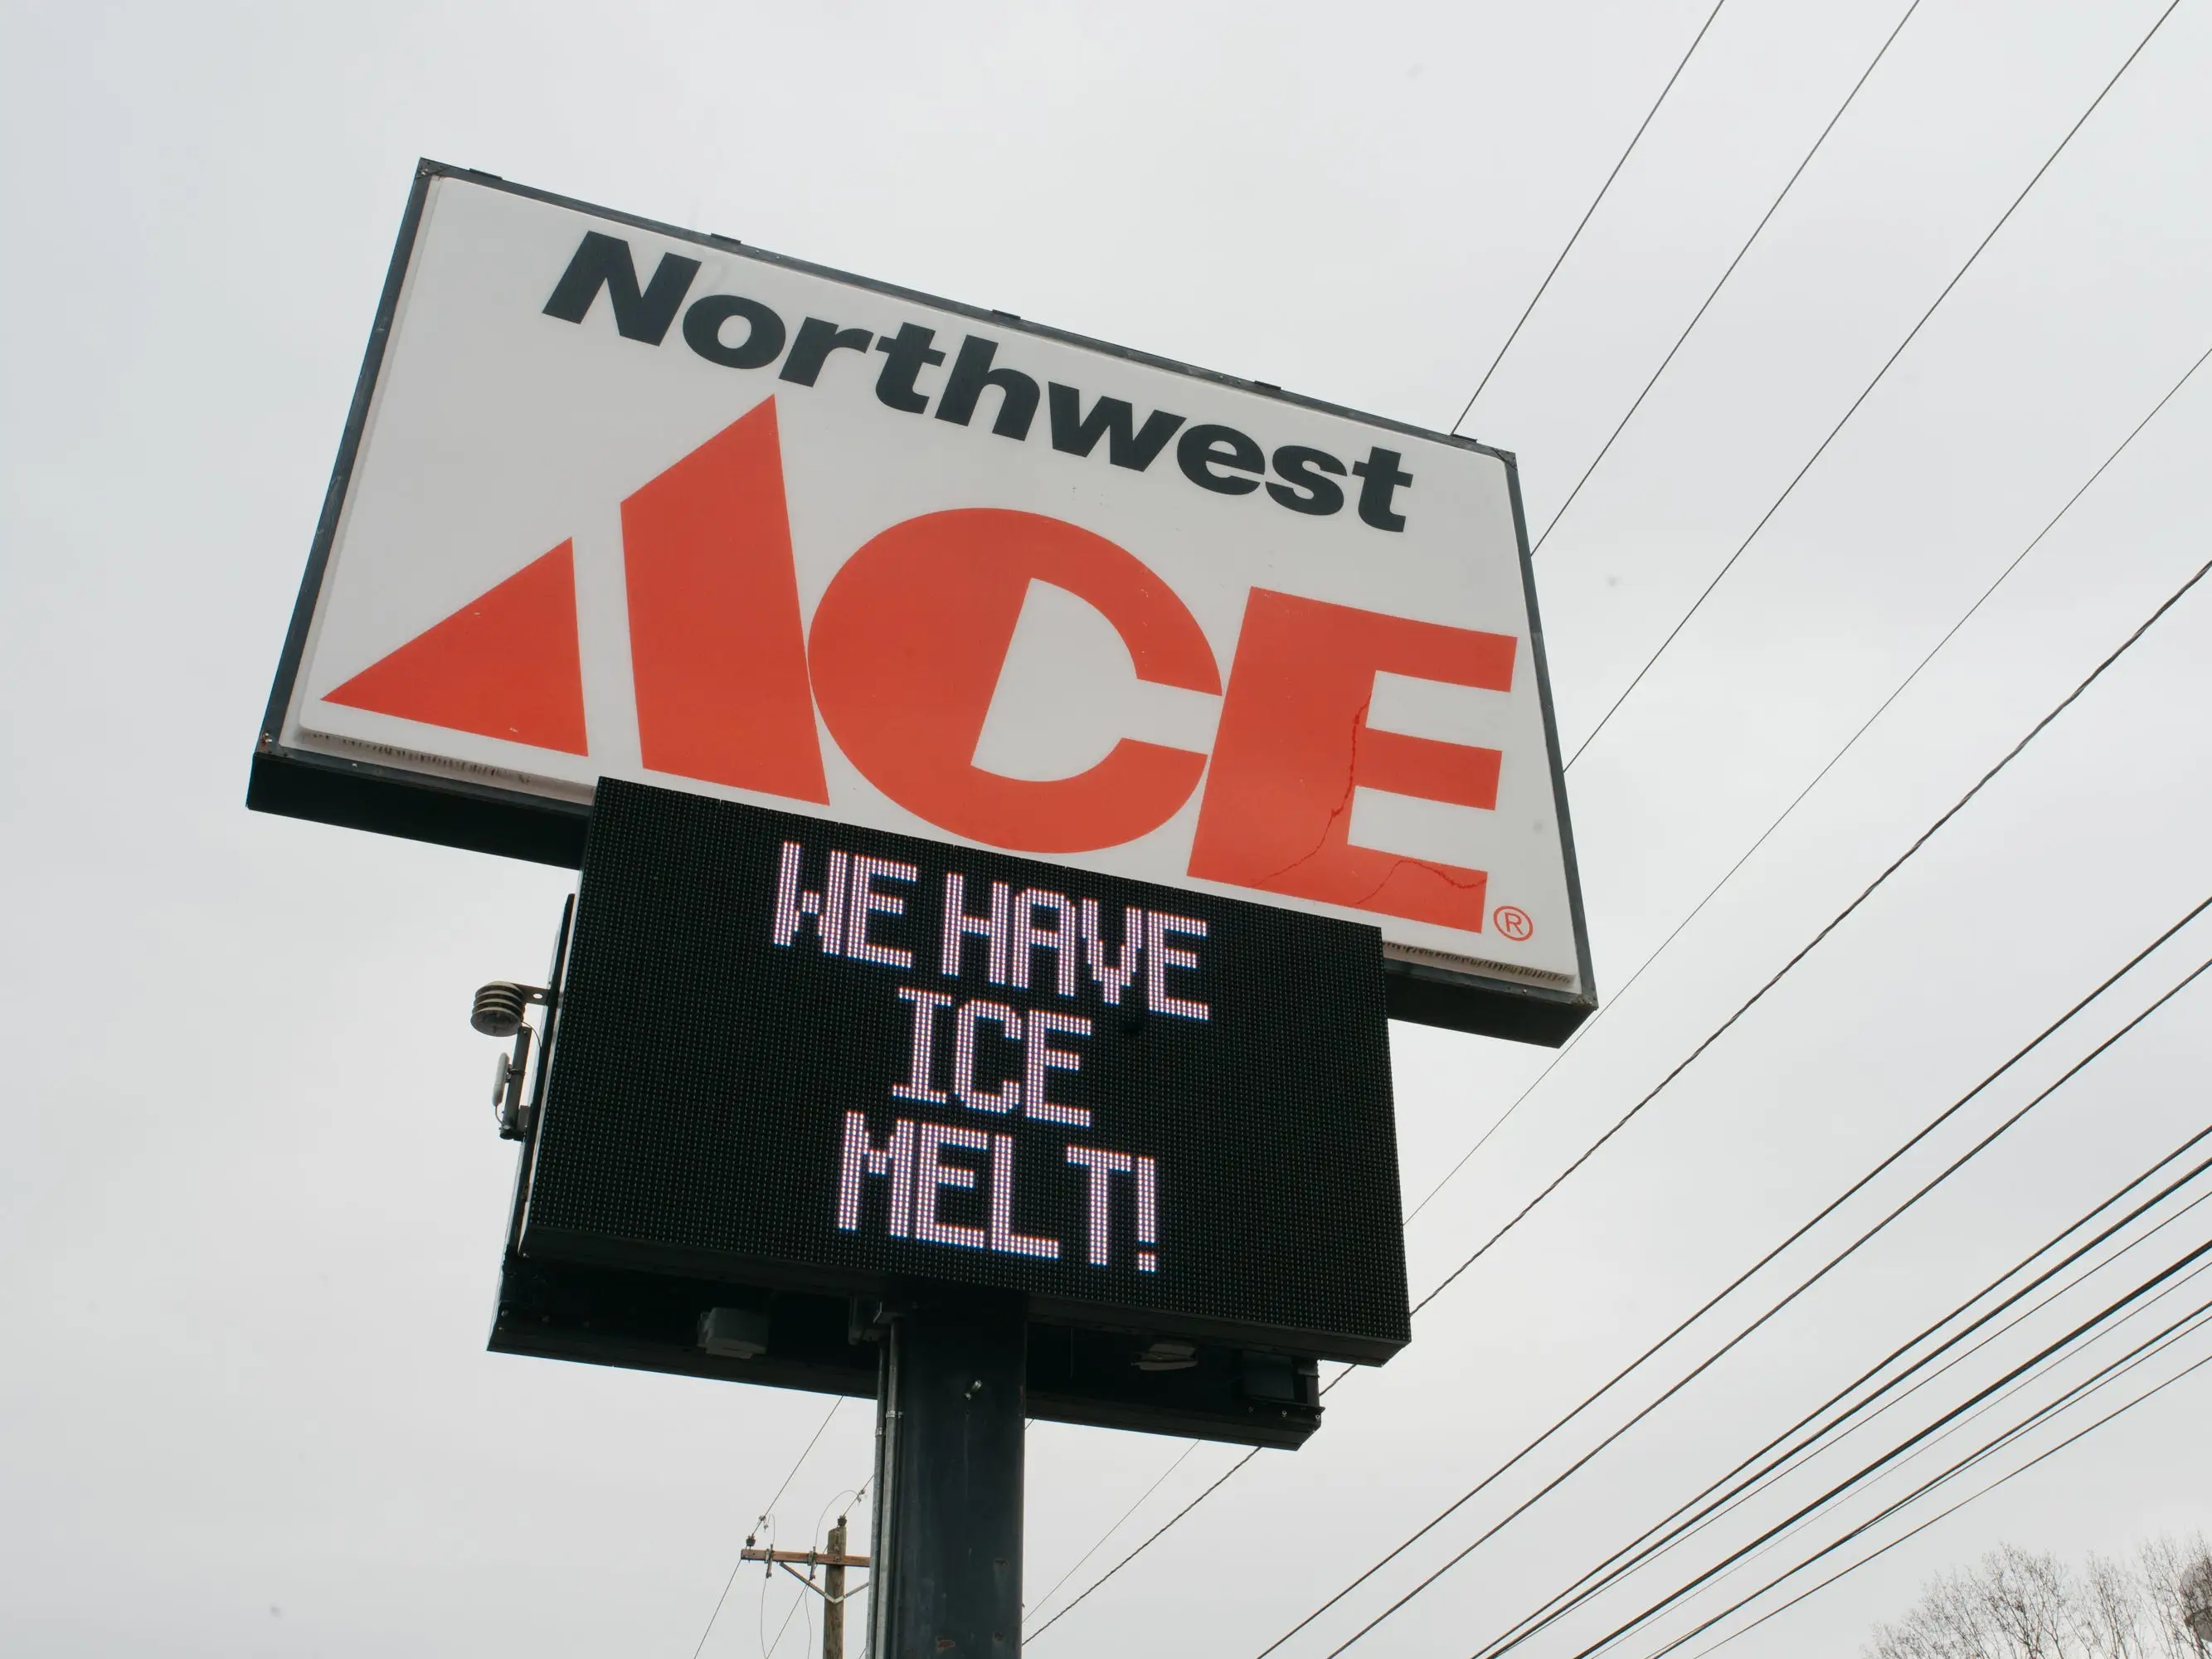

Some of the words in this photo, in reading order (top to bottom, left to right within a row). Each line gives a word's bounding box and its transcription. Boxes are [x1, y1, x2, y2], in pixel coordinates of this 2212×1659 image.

[542, 231, 1413, 533] Northwest
[320, 394, 1518, 933] ACE
[773, 840, 919, 969] WE
[941, 871, 1210, 1021] HAVE
[892, 986, 1093, 1128] ICE
[837, 1110, 1158, 1273] MELT!
